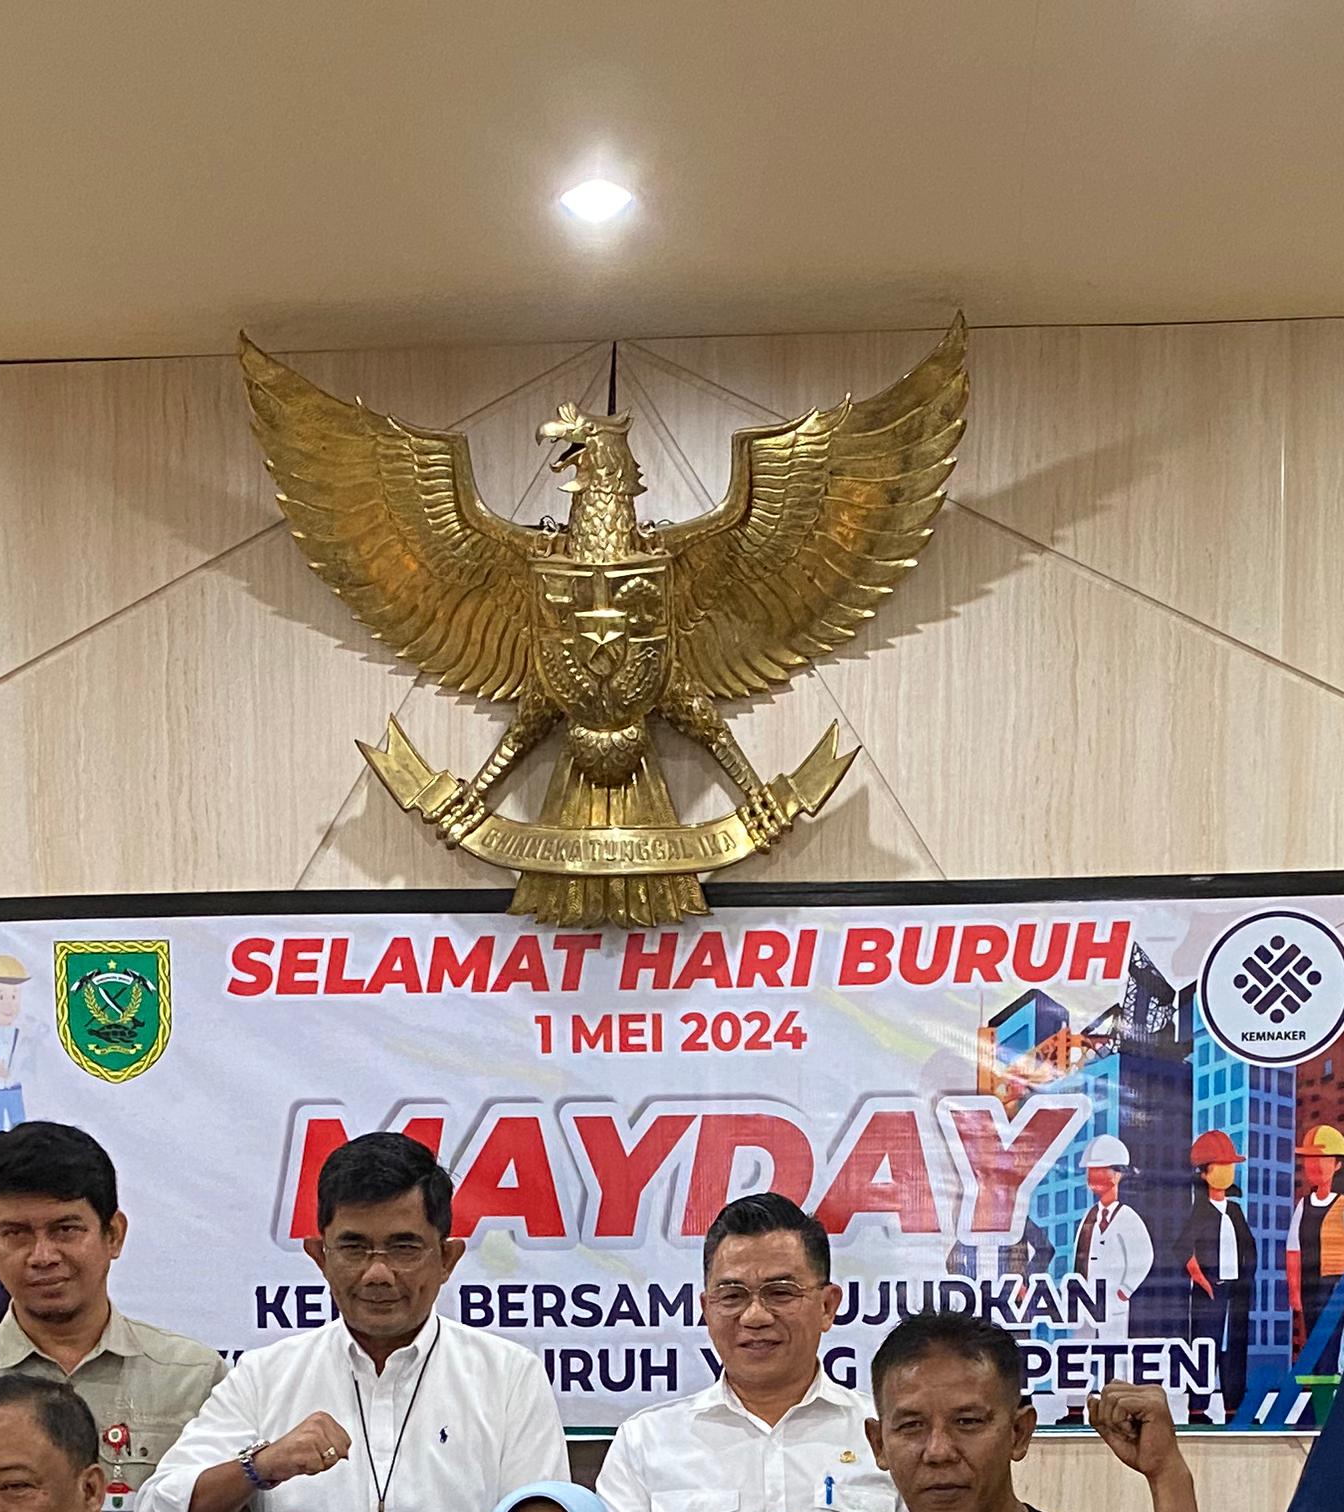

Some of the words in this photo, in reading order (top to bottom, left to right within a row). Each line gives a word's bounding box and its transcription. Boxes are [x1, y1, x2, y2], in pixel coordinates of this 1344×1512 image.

[589, 839, 694, 863] TUNGGAL
[697, 830, 738, 858] IKA
[227, 933, 601, 997] SELAMAT
[619, 929, 816, 991] HARI
[839, 920, 1131, 987] BURUH
[535, 1015, 553, 1054] 1
[571, 1012, 663, 1053] MEI
[681, 1011, 807, 1052] 2024
[1241, 1031, 1306, 1042] KEMNAKER
[459, 1284, 708, 1328] BERSAM
